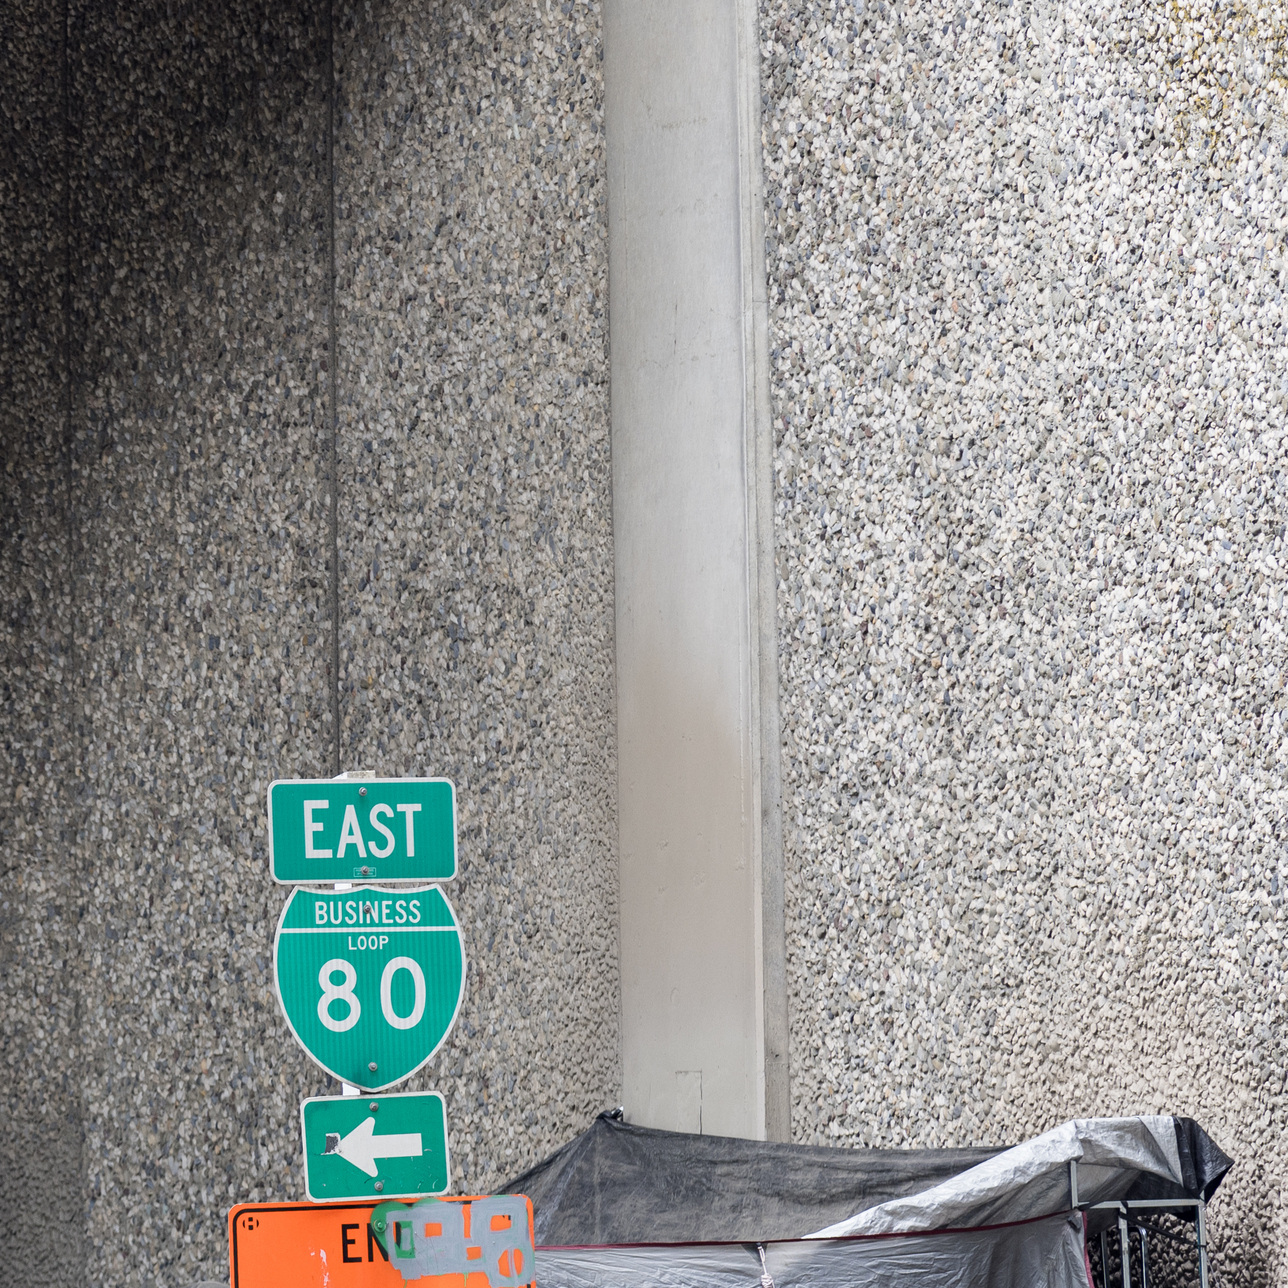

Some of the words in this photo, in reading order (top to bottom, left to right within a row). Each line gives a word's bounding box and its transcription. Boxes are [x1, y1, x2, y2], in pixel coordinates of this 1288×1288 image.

[303, 799, 423, 859] EAST
[315, 899, 421, 925] BUSINESS
[347, 935, 389, 951] LOOP
[317, 956, 427, 1033] 80
[341, 1223, 405, 1264] EN
